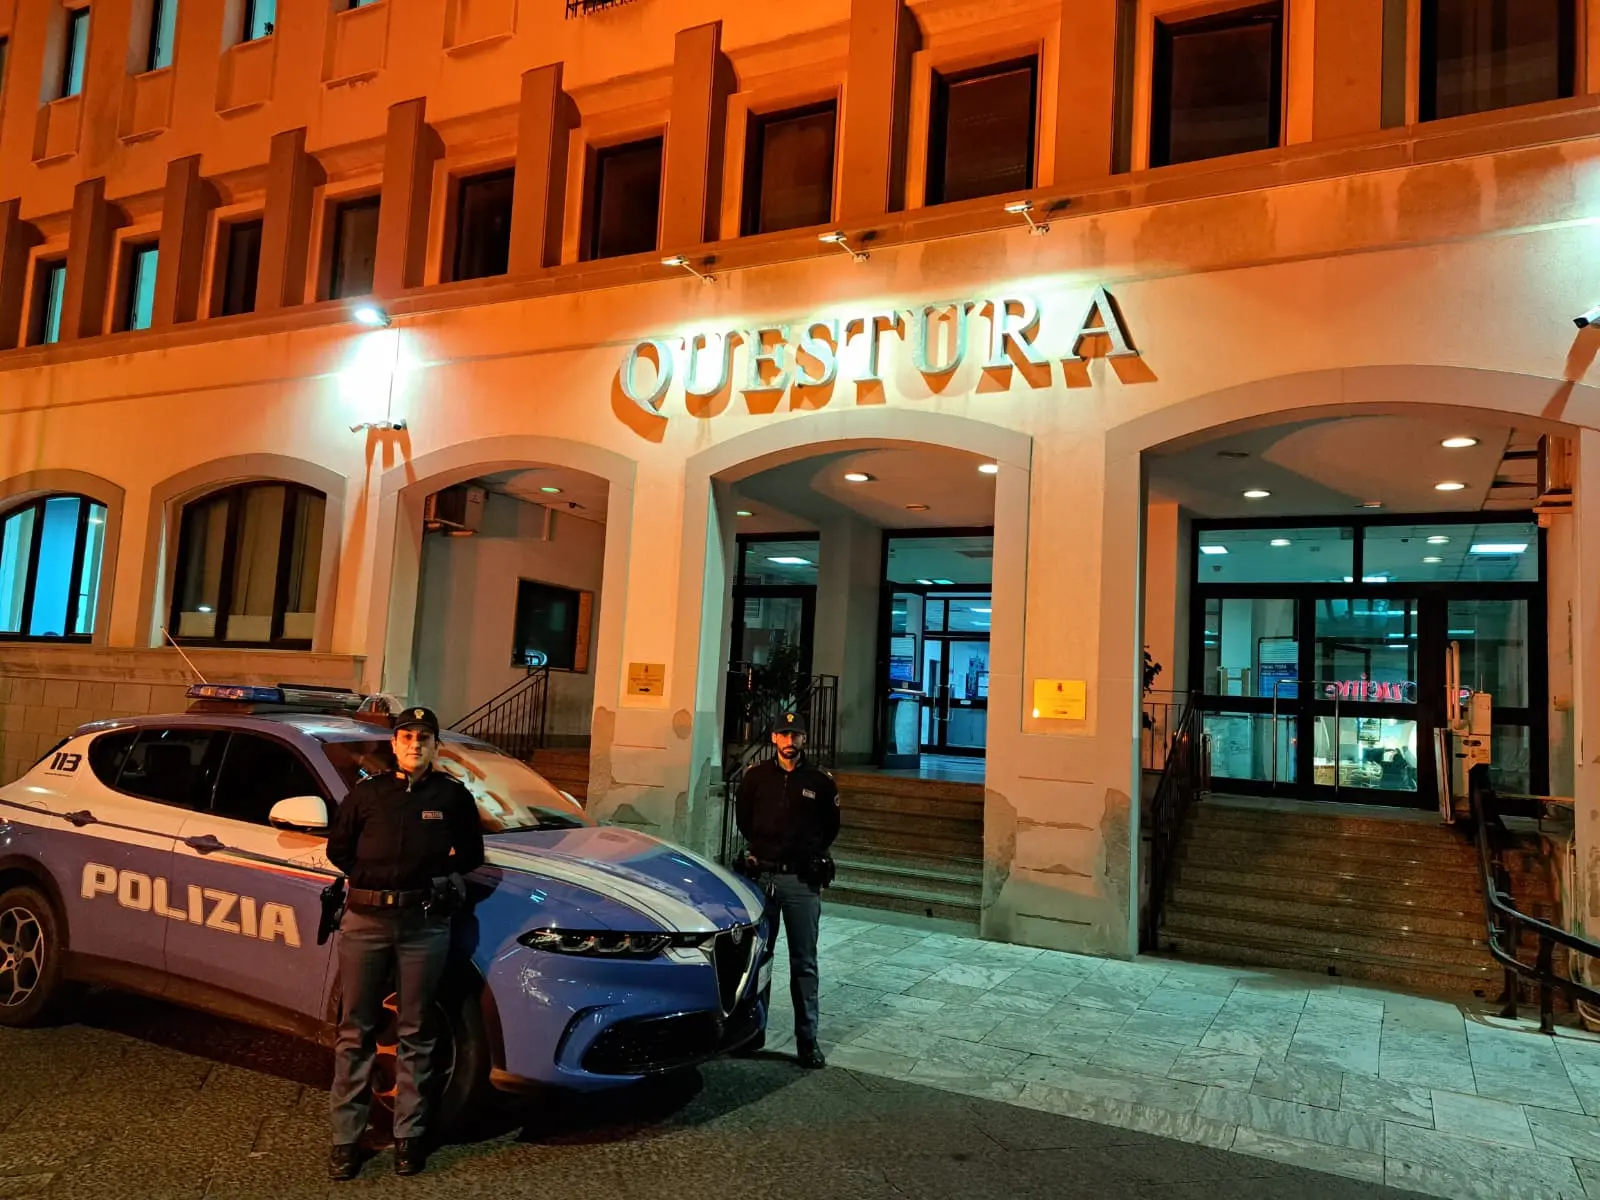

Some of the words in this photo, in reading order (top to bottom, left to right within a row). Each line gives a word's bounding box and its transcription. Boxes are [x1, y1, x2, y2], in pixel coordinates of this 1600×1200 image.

[620, 283, 1139, 419] QUESTURA
[50, 752, 82, 772] 113
[80, 861, 301, 948] POLIZIA
